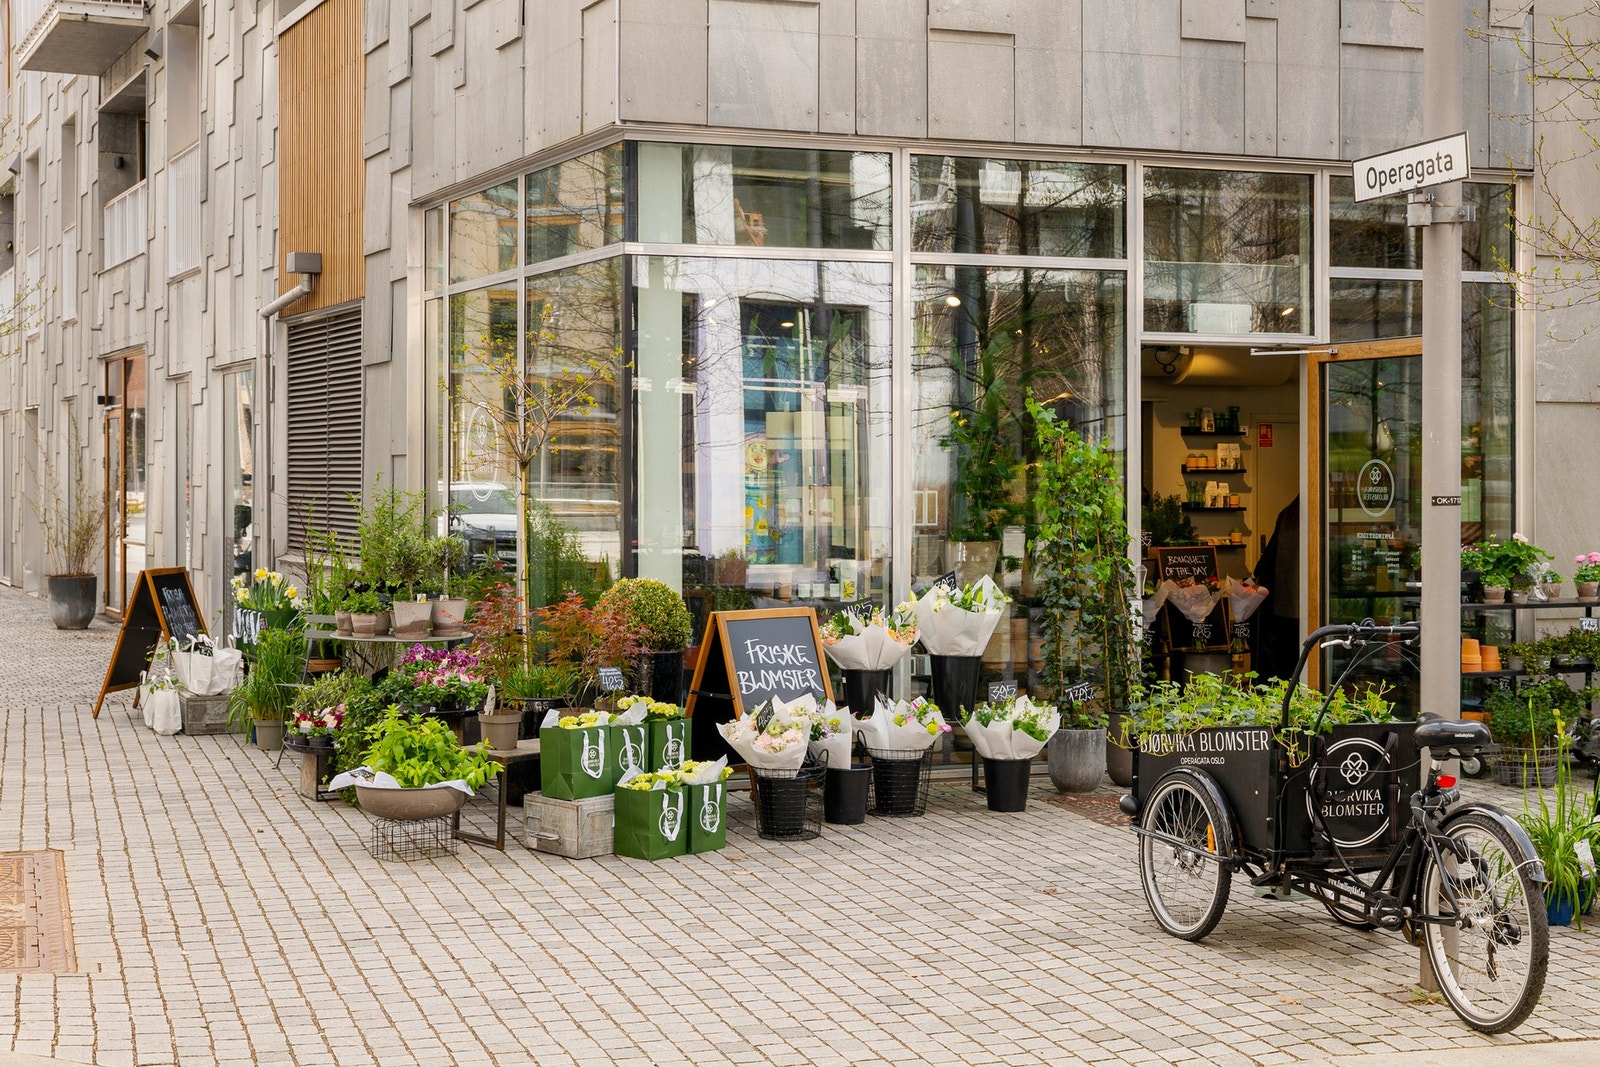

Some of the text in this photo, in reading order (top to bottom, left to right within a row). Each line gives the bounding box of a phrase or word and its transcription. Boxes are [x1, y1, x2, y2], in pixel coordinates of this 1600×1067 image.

[1366, 151, 1453, 192] Operagata
[1167, 555, 1209, 565] BOUQUET
[744, 638, 813, 666] FRISKE
[737, 668, 824, 694] BLOMSTER
[1140, 730, 1270, 753] BJØRVIKA BLOMSTER
[1180, 756, 1225, 765] OPERAGATA OSLO
[1325, 788, 1382, 803] RVIKA
[1321, 803, 1384, 818] BLOMSTER
